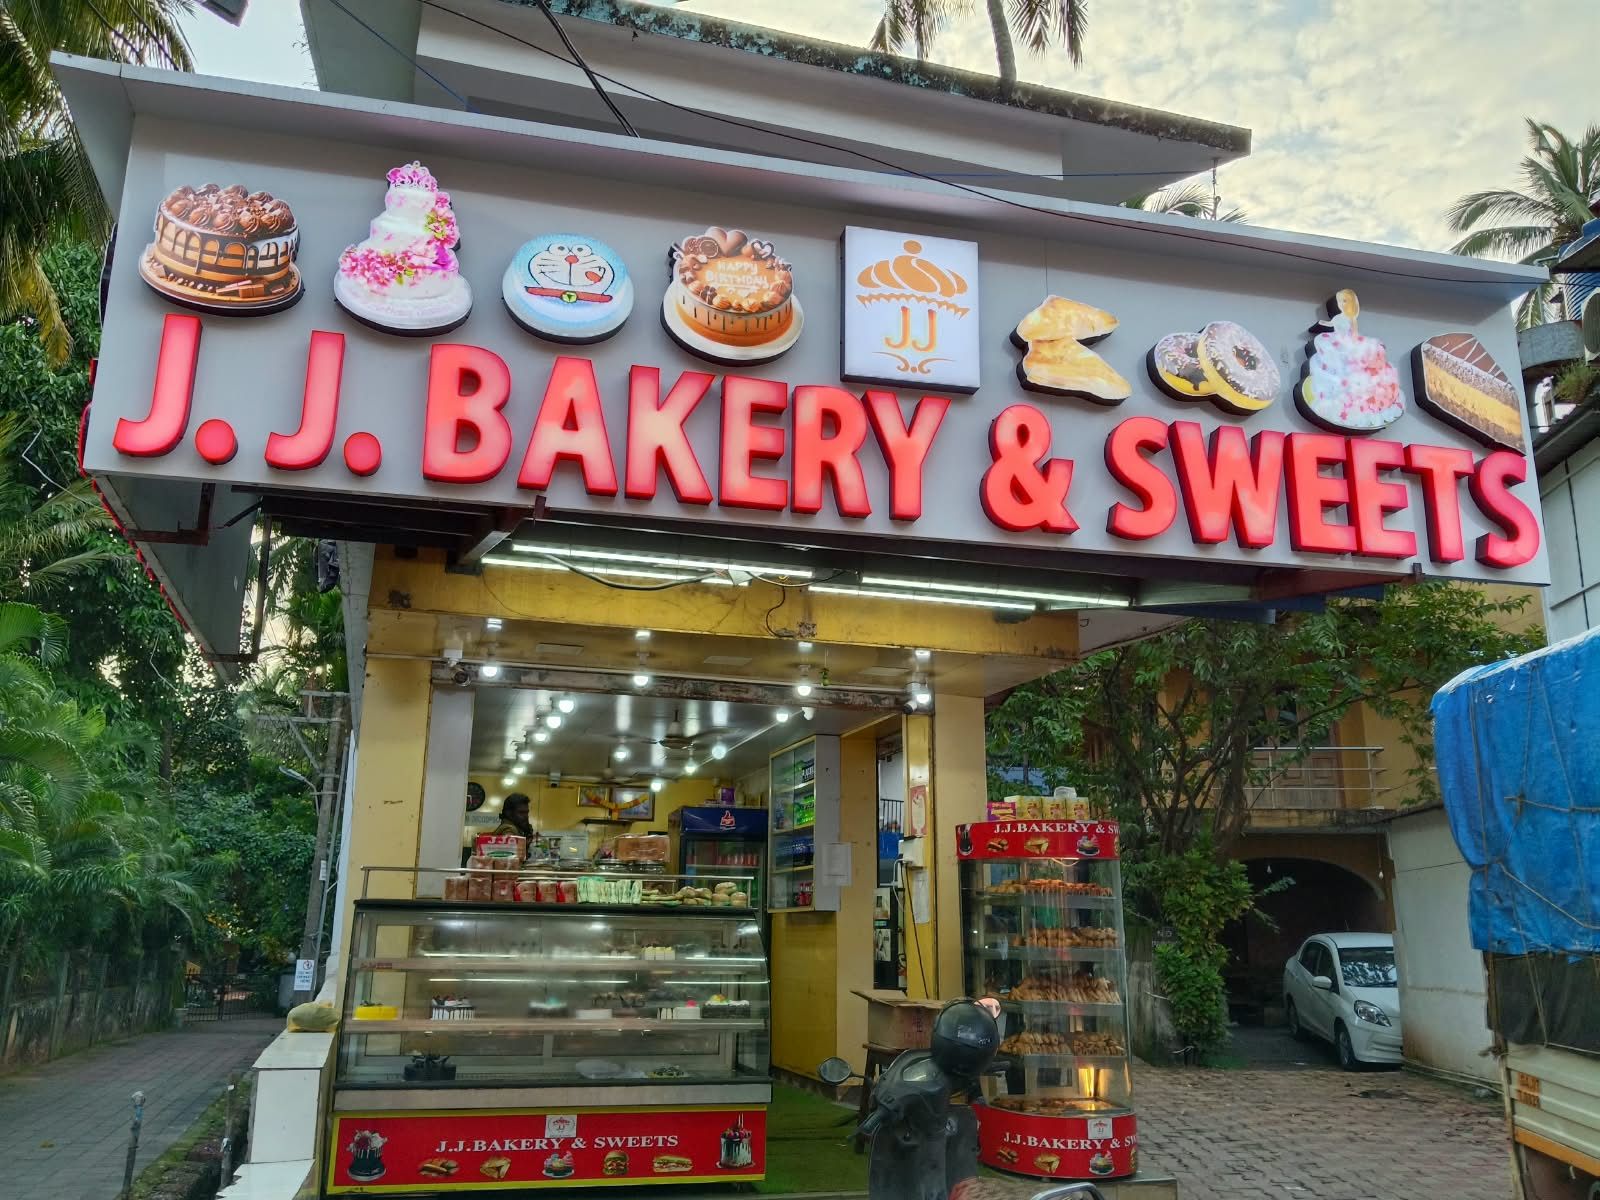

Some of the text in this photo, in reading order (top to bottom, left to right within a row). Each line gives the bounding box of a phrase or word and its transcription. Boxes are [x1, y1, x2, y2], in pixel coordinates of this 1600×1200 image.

[884, 306, 937, 352] JJ
[422, 343, 952, 522] BAKERY
[979, 404, 1081, 535] &
[1105, 416, 1541, 569] SWEETS
[1095, 824, 1105, 834] &
[571, 1138, 587, 1149] &
[594, 1135, 679, 1148] SWEETS
[1110, 1138, 1121, 1149] &
